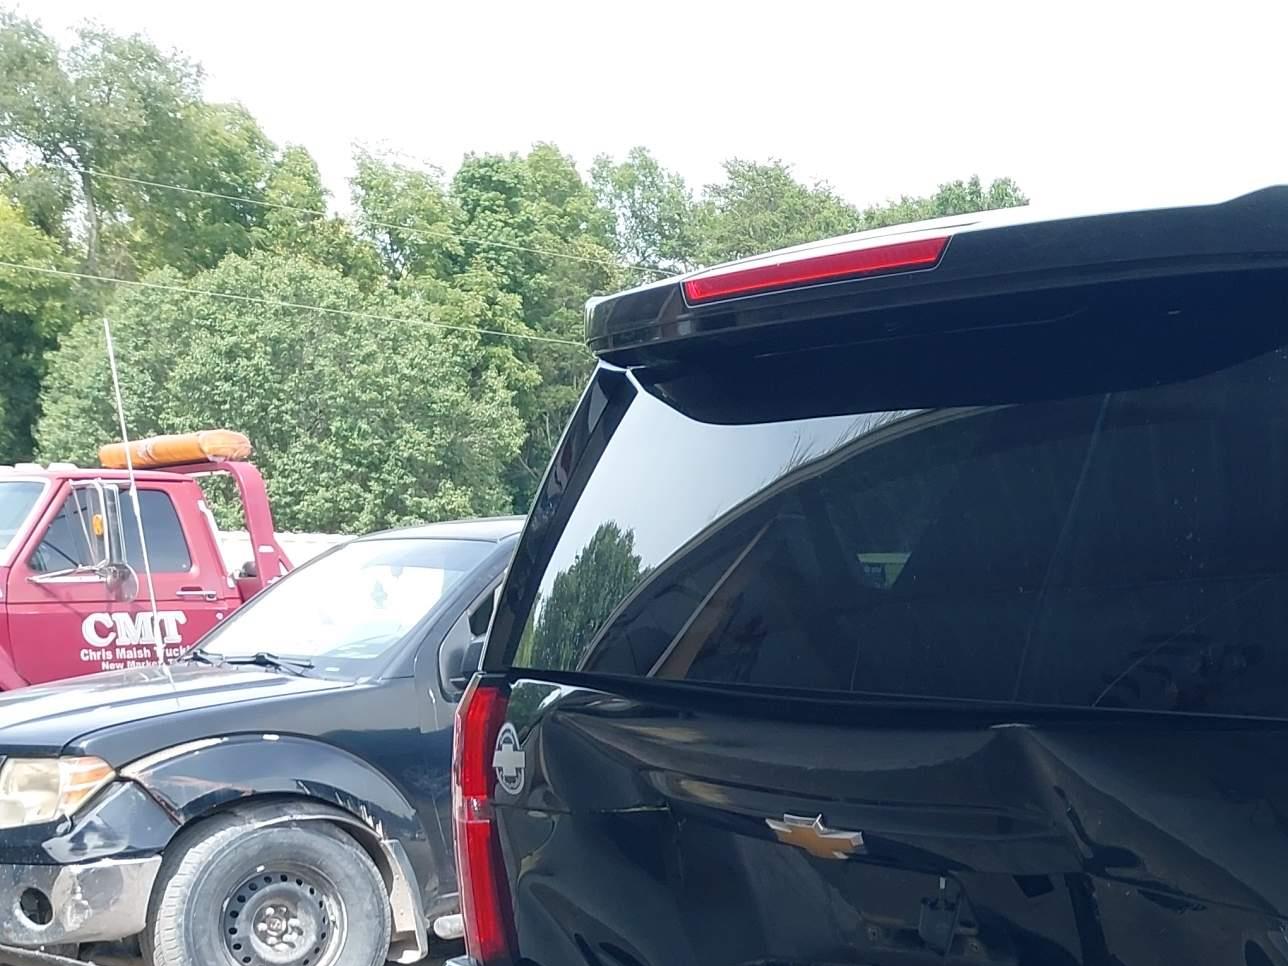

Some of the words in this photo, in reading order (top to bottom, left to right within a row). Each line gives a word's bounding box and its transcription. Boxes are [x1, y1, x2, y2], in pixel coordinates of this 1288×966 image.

[82, 610, 187, 647] CMT
[80, 648, 113, 662] Chris
[101, 660, 124, 671] New
